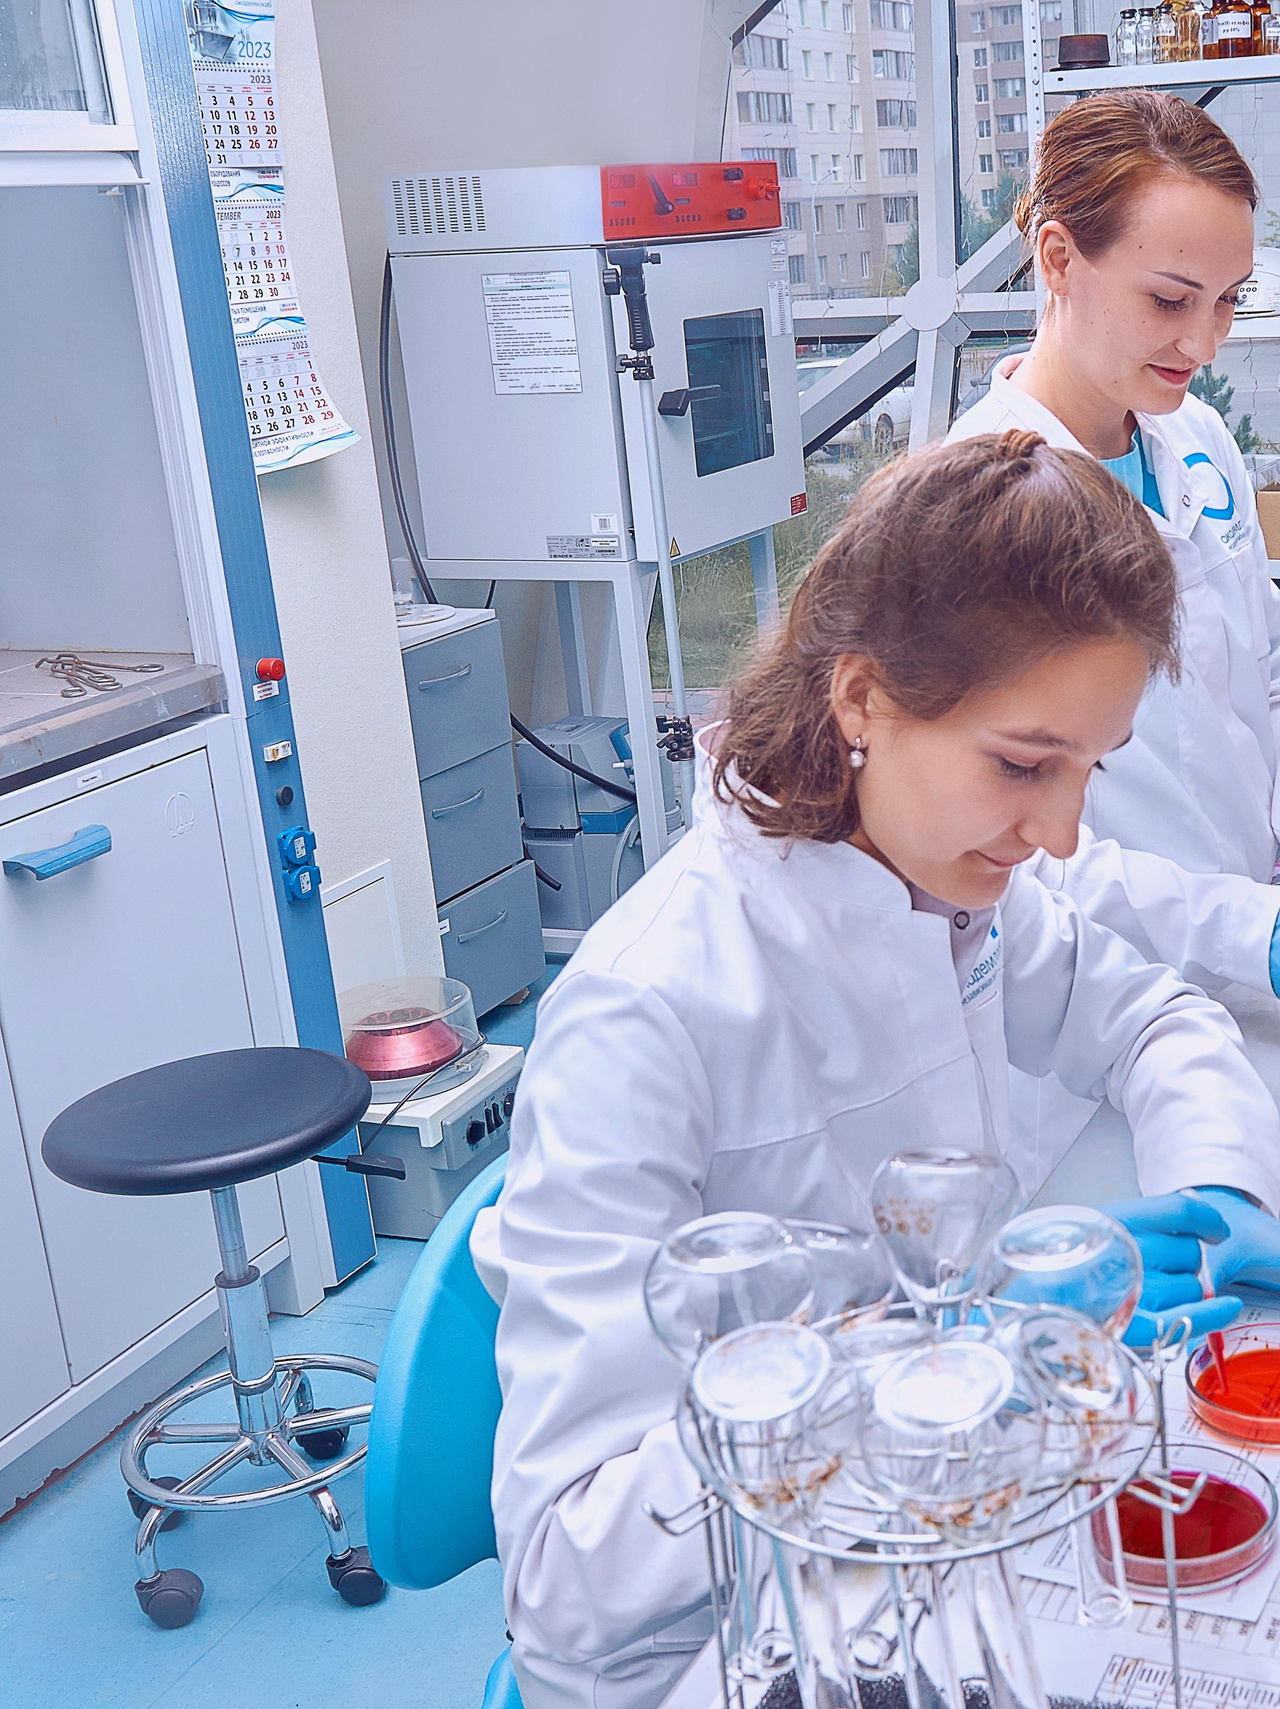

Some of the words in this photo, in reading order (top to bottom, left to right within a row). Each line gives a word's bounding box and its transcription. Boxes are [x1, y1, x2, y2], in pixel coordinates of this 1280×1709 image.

[238, 41, 271, 58] 2023
[250, 75, 272, 84] 2023
[212, 96, 217, 105] 3
[230, 96, 235, 106] 4
[248, 97, 253, 106] 5
[268, 97, 273, 106] 6
[210, 110, 220, 120] 10
[227, 111, 236, 120] 11
[245, 111, 256, 120] 12
[264, 111, 275, 120] 13
[212, 125, 222, 134] 17
[229, 125, 240, 135] 18
[247, 125, 257, 135] 19
[265, 125, 276, 134] 20
[215, 139, 225, 149] 24
[231, 139, 242, 149] 25
[249, 139, 260, 149] 26
[268, 139, 278, 148] 27
[217, 154, 226, 164] 31
[266, 210, 281, 219] 2023
[250, 233, 253, 242] 1
[264, 232, 268, 241] 2
[278, 231, 282, 240] 3
[236, 247, 240, 257] 7
[251, 246, 256, 256] 8
[266, 246, 270, 255] 9
[276, 245, 285, 254] 10
[234, 262, 242, 271] 14
[249, 261, 258, 270] 15
[264, 260, 273, 268] 16
[278, 259, 286, 268] 17
[236, 276, 244, 285] 21
[251, 275, 260, 284] 22
[266, 273, 275, 282] 23
[281, 272, 290, 281] 24
[238, 290, 248, 299] 28
[254, 289, 263, 298] 29
[269, 287, 278, 297] 30
[292, 341, 308, 350] 2023
[308, 360, 312, 369] 1
[247, 383, 252, 392] 4
[263, 381, 268, 390] 5
[279, 378, 284, 387] 6
[294, 376, 299, 385] 7
[311, 373, 317, 382] 8
[245, 397, 254, 407] 11
[261, 394, 271, 404] 12
[277, 392, 287, 402] 13
[294, 389, 304, 399] 14
[310, 386, 321, 396] 15
[248, 410, 258, 420] 18
[264, 408, 274, 418] 19
[280, 405, 292, 415] 20
[297, 402, 308, 412] 21
[315, 399, 328, 408] 22
[251, 425, 261, 435] 25
[267, 422, 279, 431] 26
[285, 419, 295, 428] 27
[302, 415, 315, 424] 28
[321, 411, 334, 420] 29
